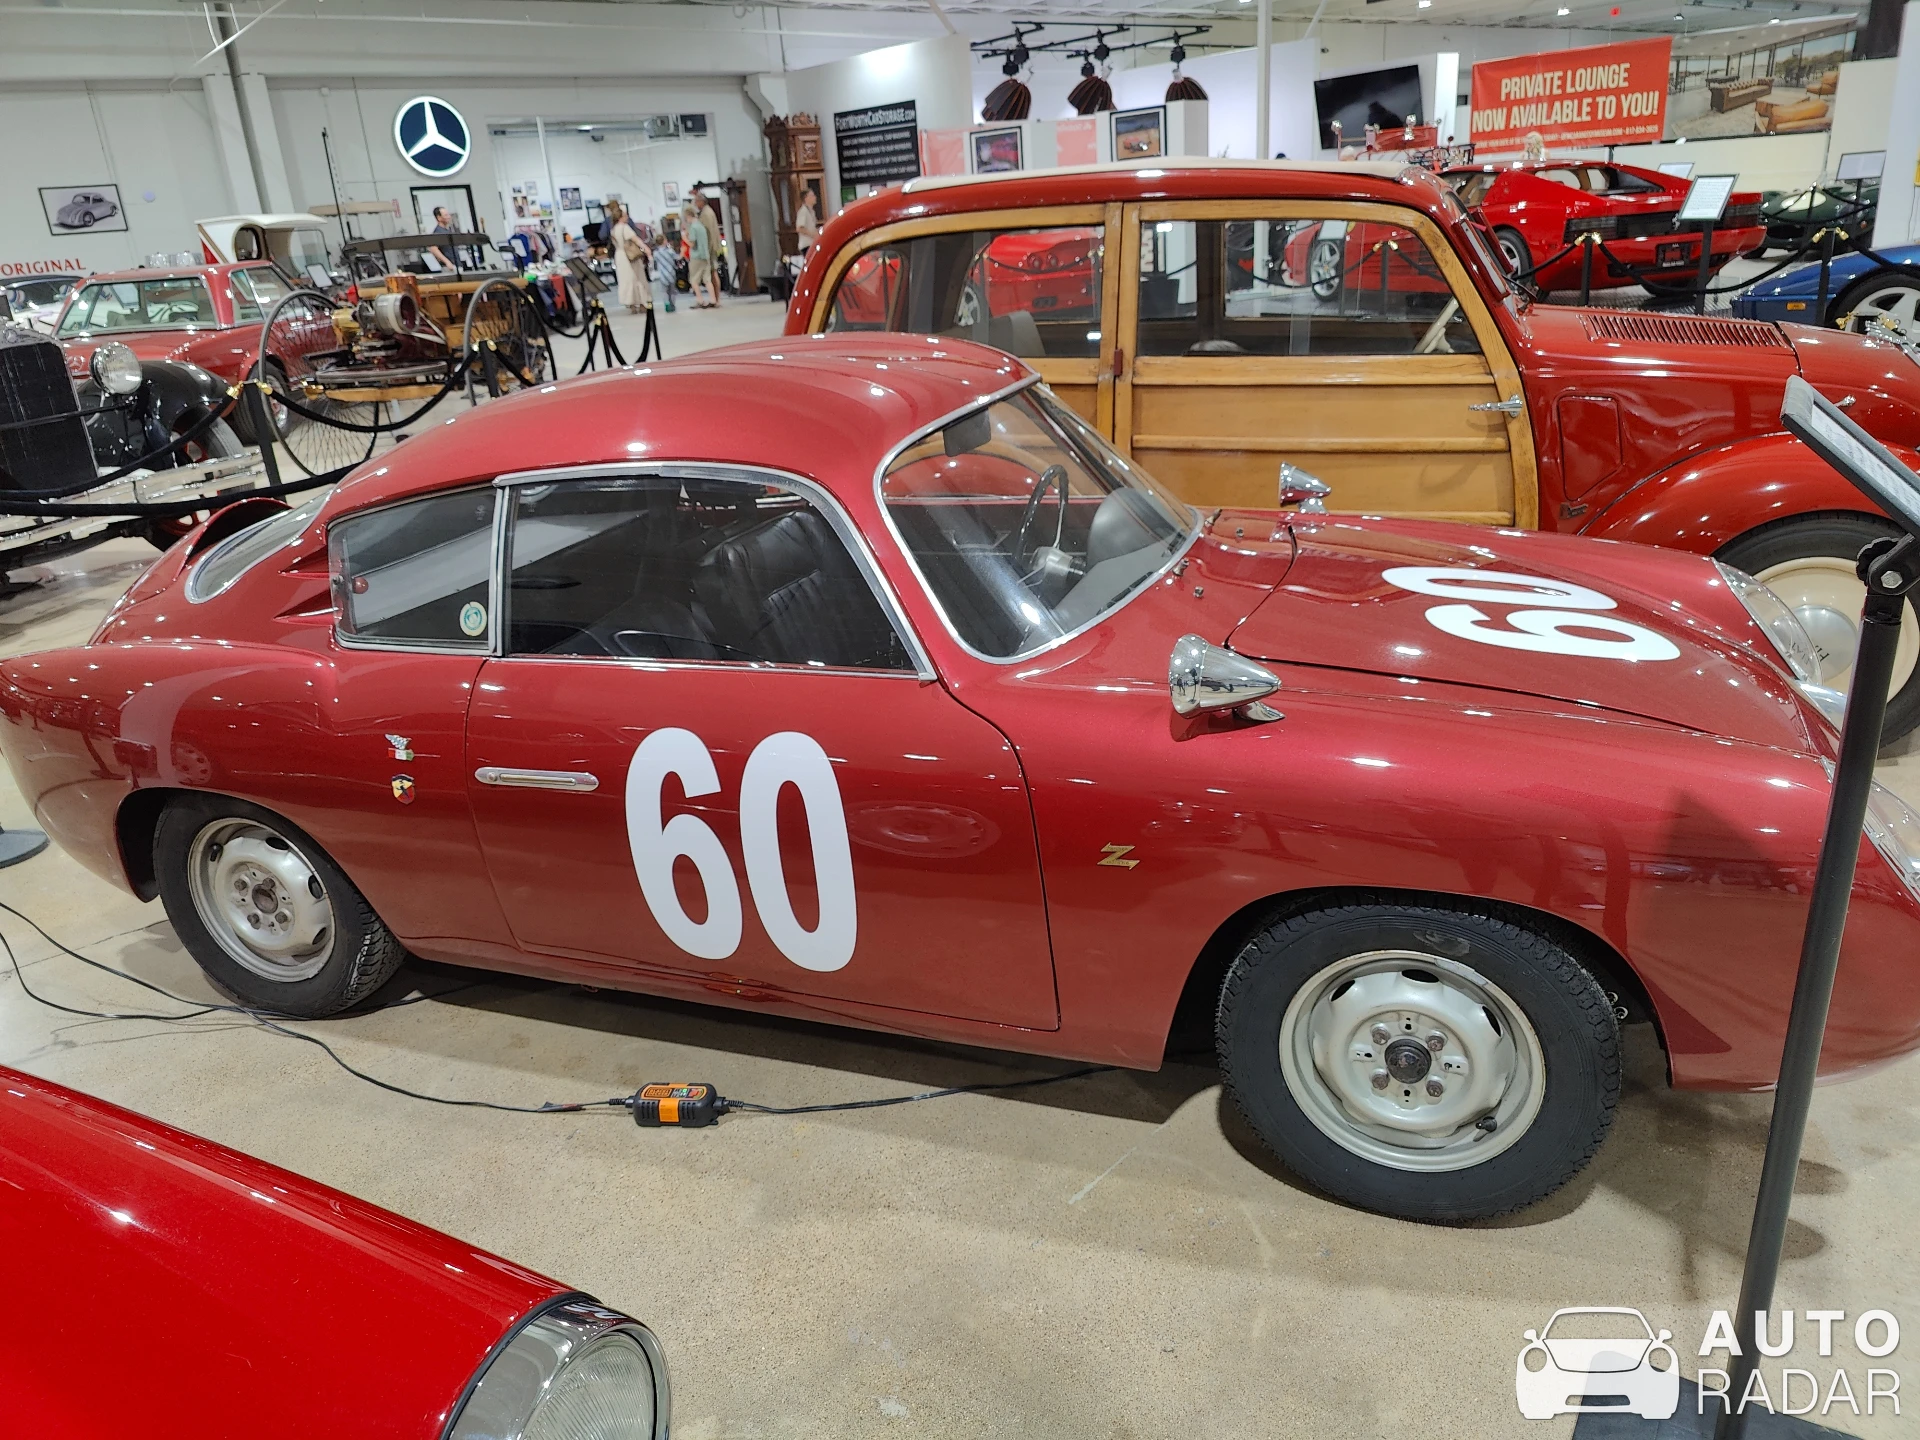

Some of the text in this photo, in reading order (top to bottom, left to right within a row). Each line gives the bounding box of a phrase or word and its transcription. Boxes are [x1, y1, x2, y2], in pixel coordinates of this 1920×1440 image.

[1501, 63, 1630, 101] PRIVATE LOUNGE
[1472, 90, 1660, 133] NOW AVAILABLE TO YOU!
[0, 258, 86, 276] ORIGINAL
[625, 726, 858, 972] 60
